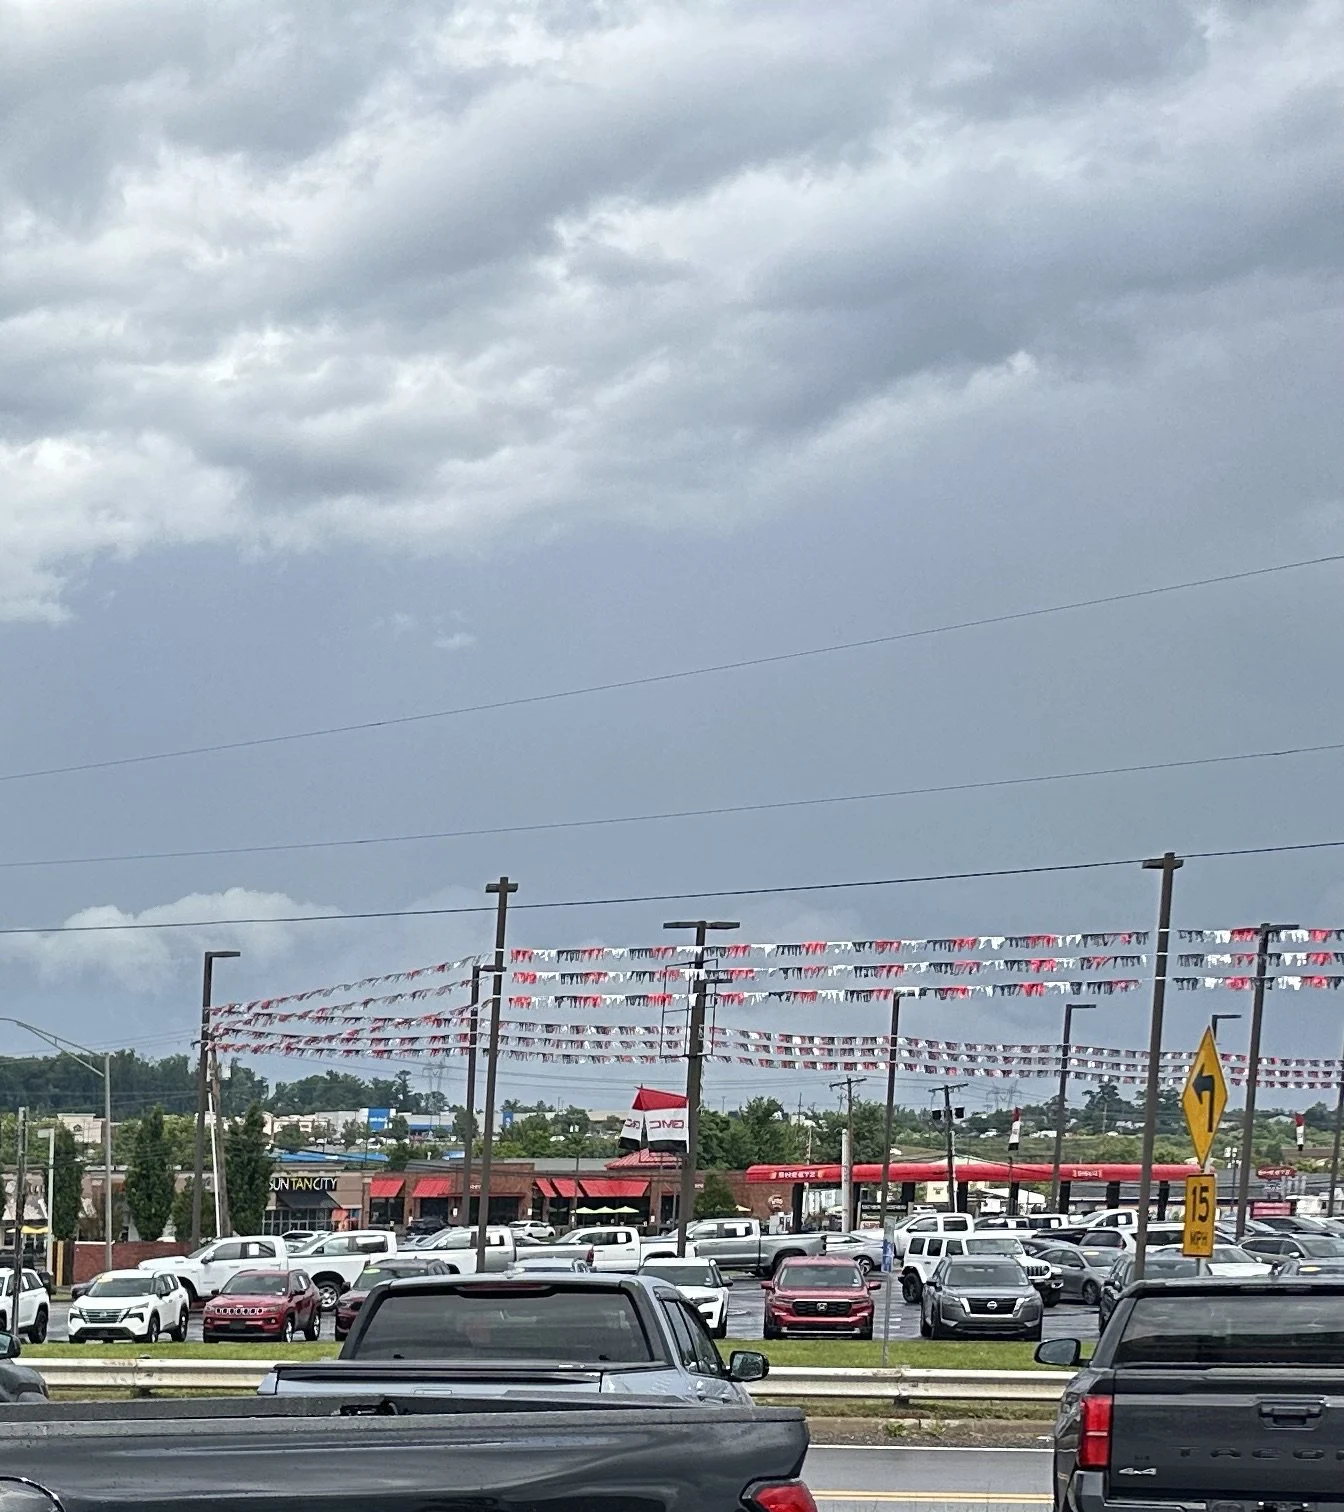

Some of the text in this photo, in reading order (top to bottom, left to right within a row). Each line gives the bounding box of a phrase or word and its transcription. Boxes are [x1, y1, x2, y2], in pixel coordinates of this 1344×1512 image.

[269, 1177, 337, 1191] SUN TAN CITY
[1192, 1186, 1210, 1222] 15
[1170, 1446, 1344, 1461] TACO
